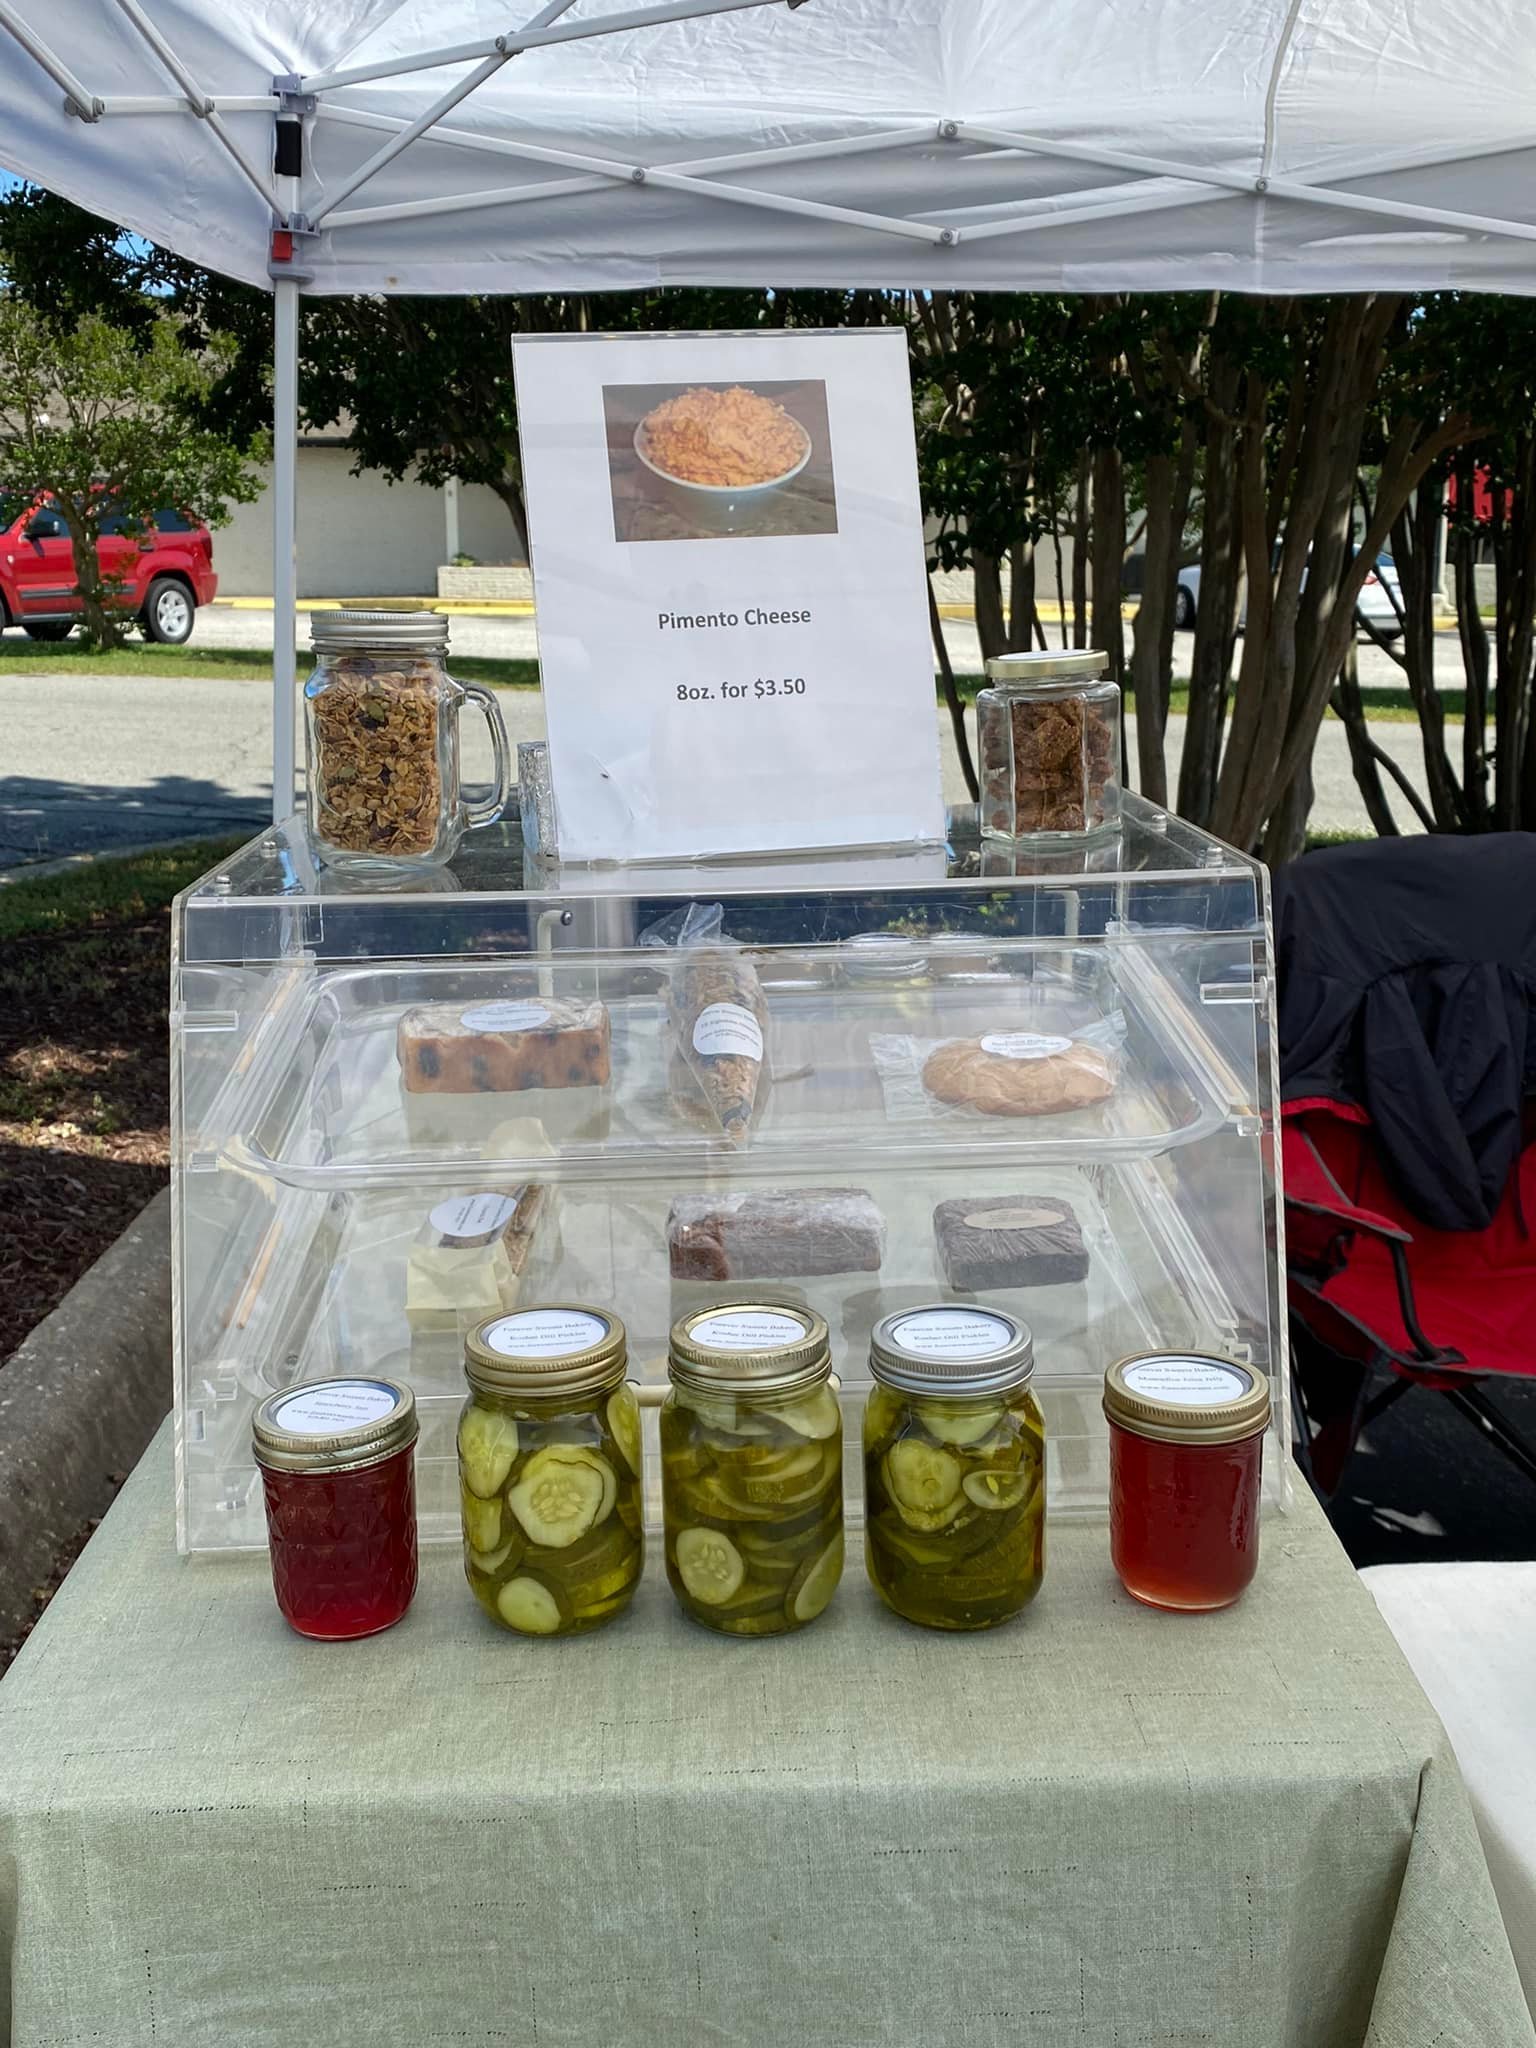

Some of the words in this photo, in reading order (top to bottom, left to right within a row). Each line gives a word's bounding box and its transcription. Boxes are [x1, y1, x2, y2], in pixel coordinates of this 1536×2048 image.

[658, 611, 739, 630] Pimento
[744, 607, 812, 626] Cheese
[676, 683, 715, 701] 8oz.
[720, 681, 748, 699] for
[754, 678, 806, 699] $3.50
